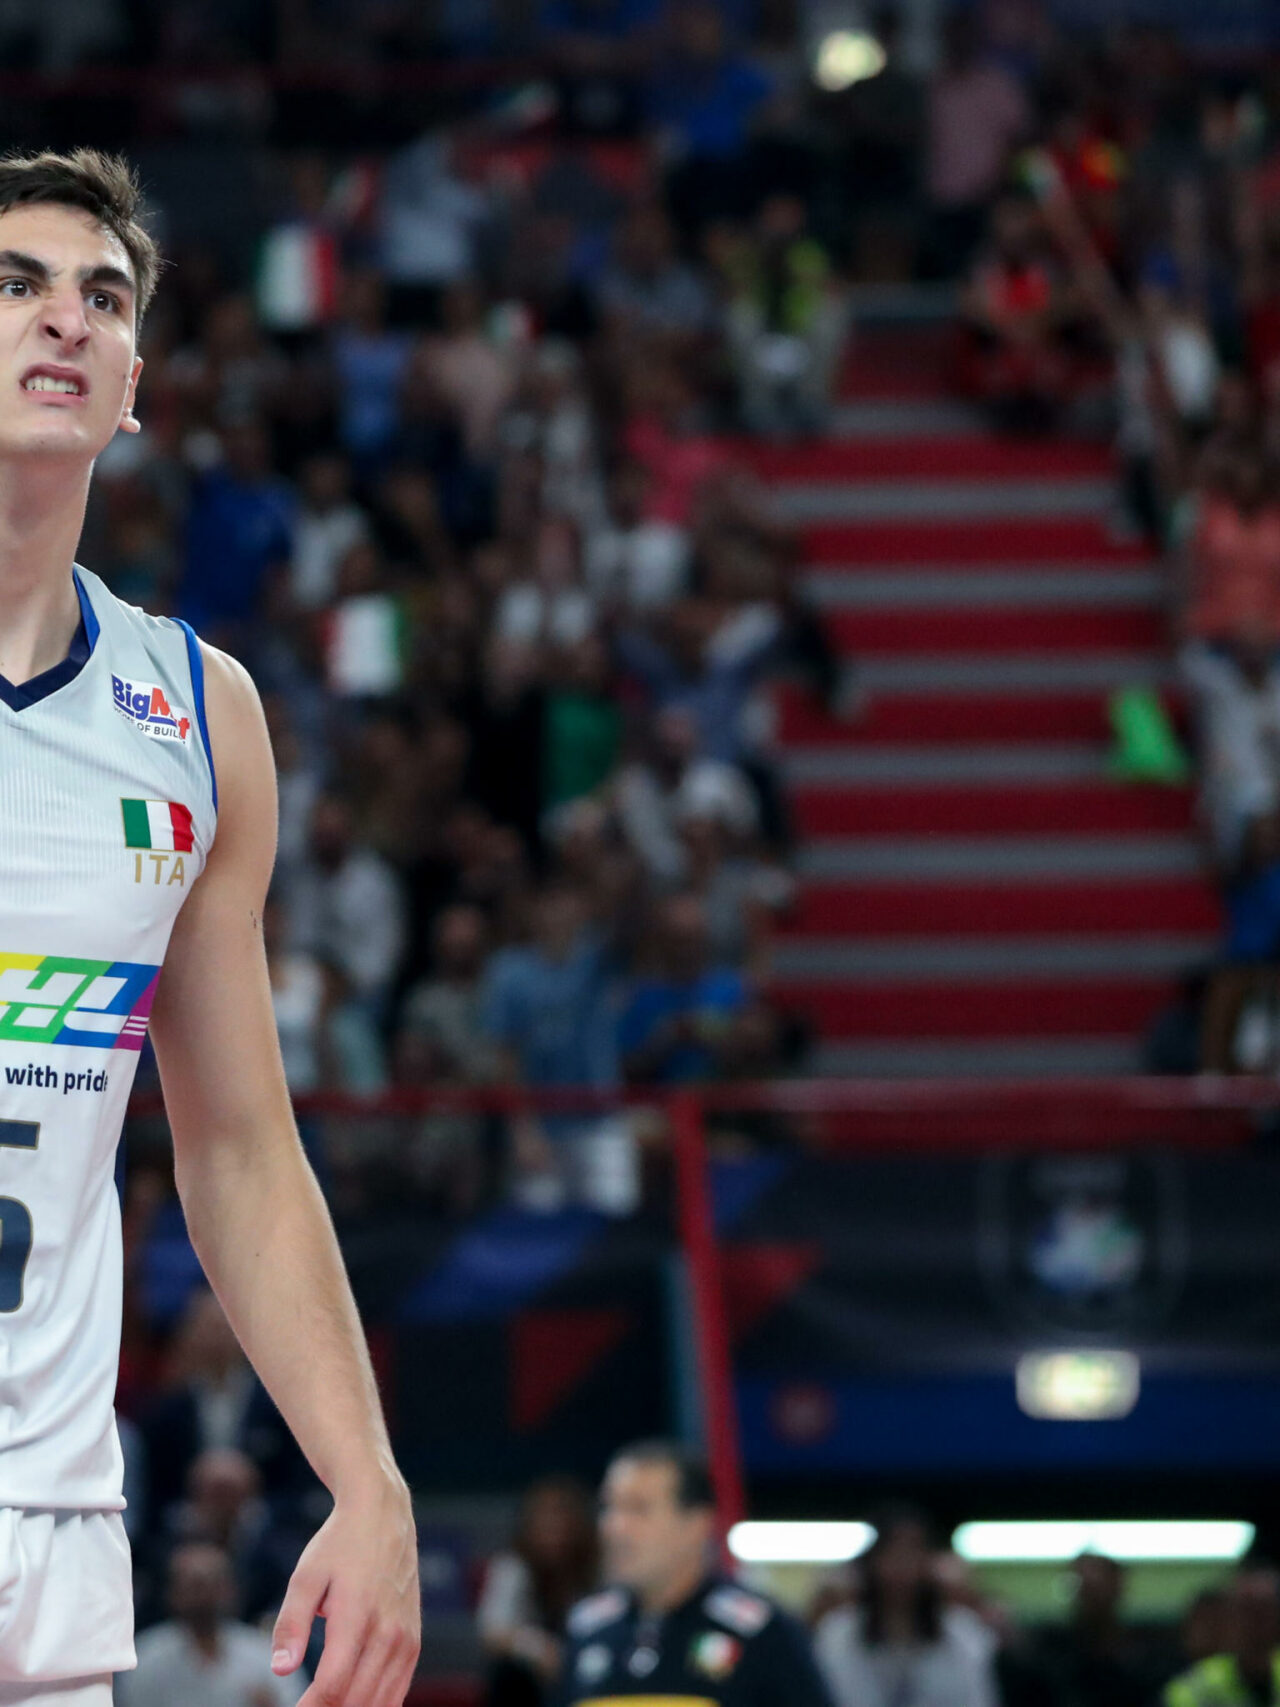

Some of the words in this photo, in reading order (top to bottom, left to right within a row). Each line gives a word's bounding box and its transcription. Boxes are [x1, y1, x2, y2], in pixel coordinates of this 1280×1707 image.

[111, 674, 191, 740] BigMt
[136, 722, 151, 733] OF
[153, 726, 182, 740] BUIL
[135, 853, 185, 887] ITA
[5, 1063, 58, 1088] with
[63, 1068, 109, 1095] prid
